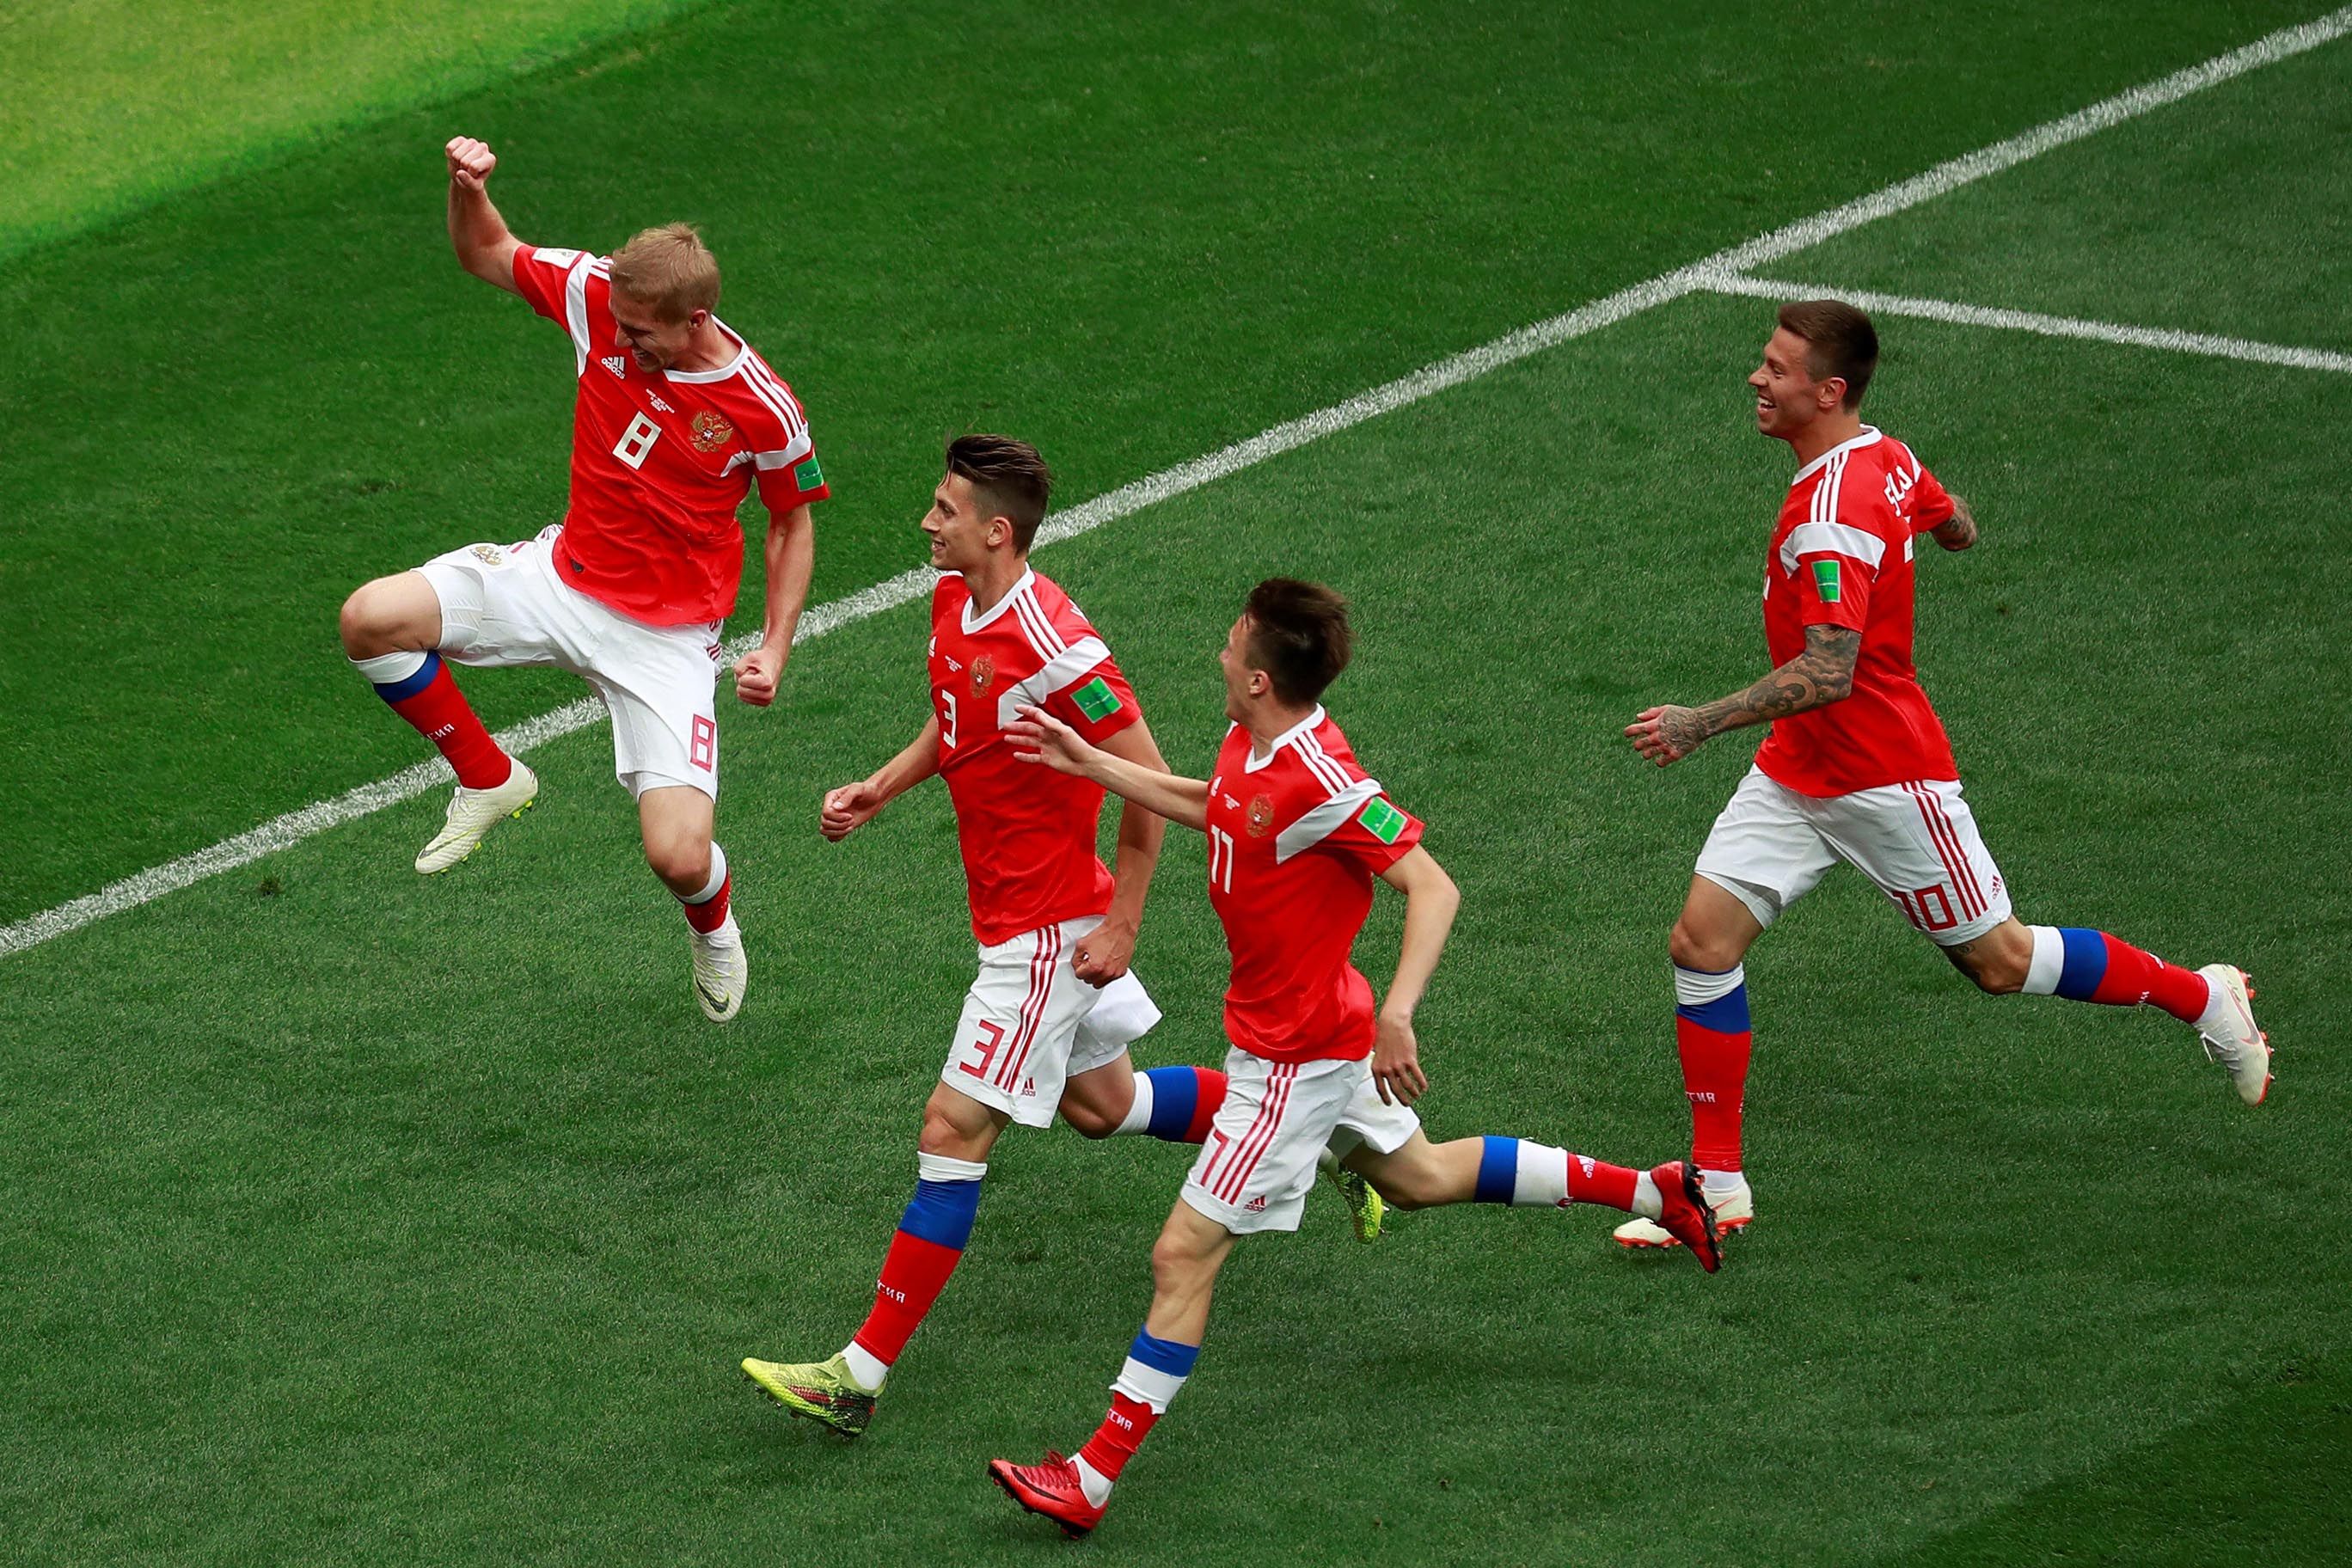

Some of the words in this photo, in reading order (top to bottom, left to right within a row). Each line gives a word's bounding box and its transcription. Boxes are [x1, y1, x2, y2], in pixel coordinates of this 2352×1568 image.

[601, 357, 626, 380] adidas
[612, 411, 662, 470] 8
[689, 714, 715, 773] 8
[941, 689, 957, 749] 3
[1210, 824, 1234, 894] 17
[1891, 883, 1958, 932] 10
[959, 1019, 1006, 1081] 3
